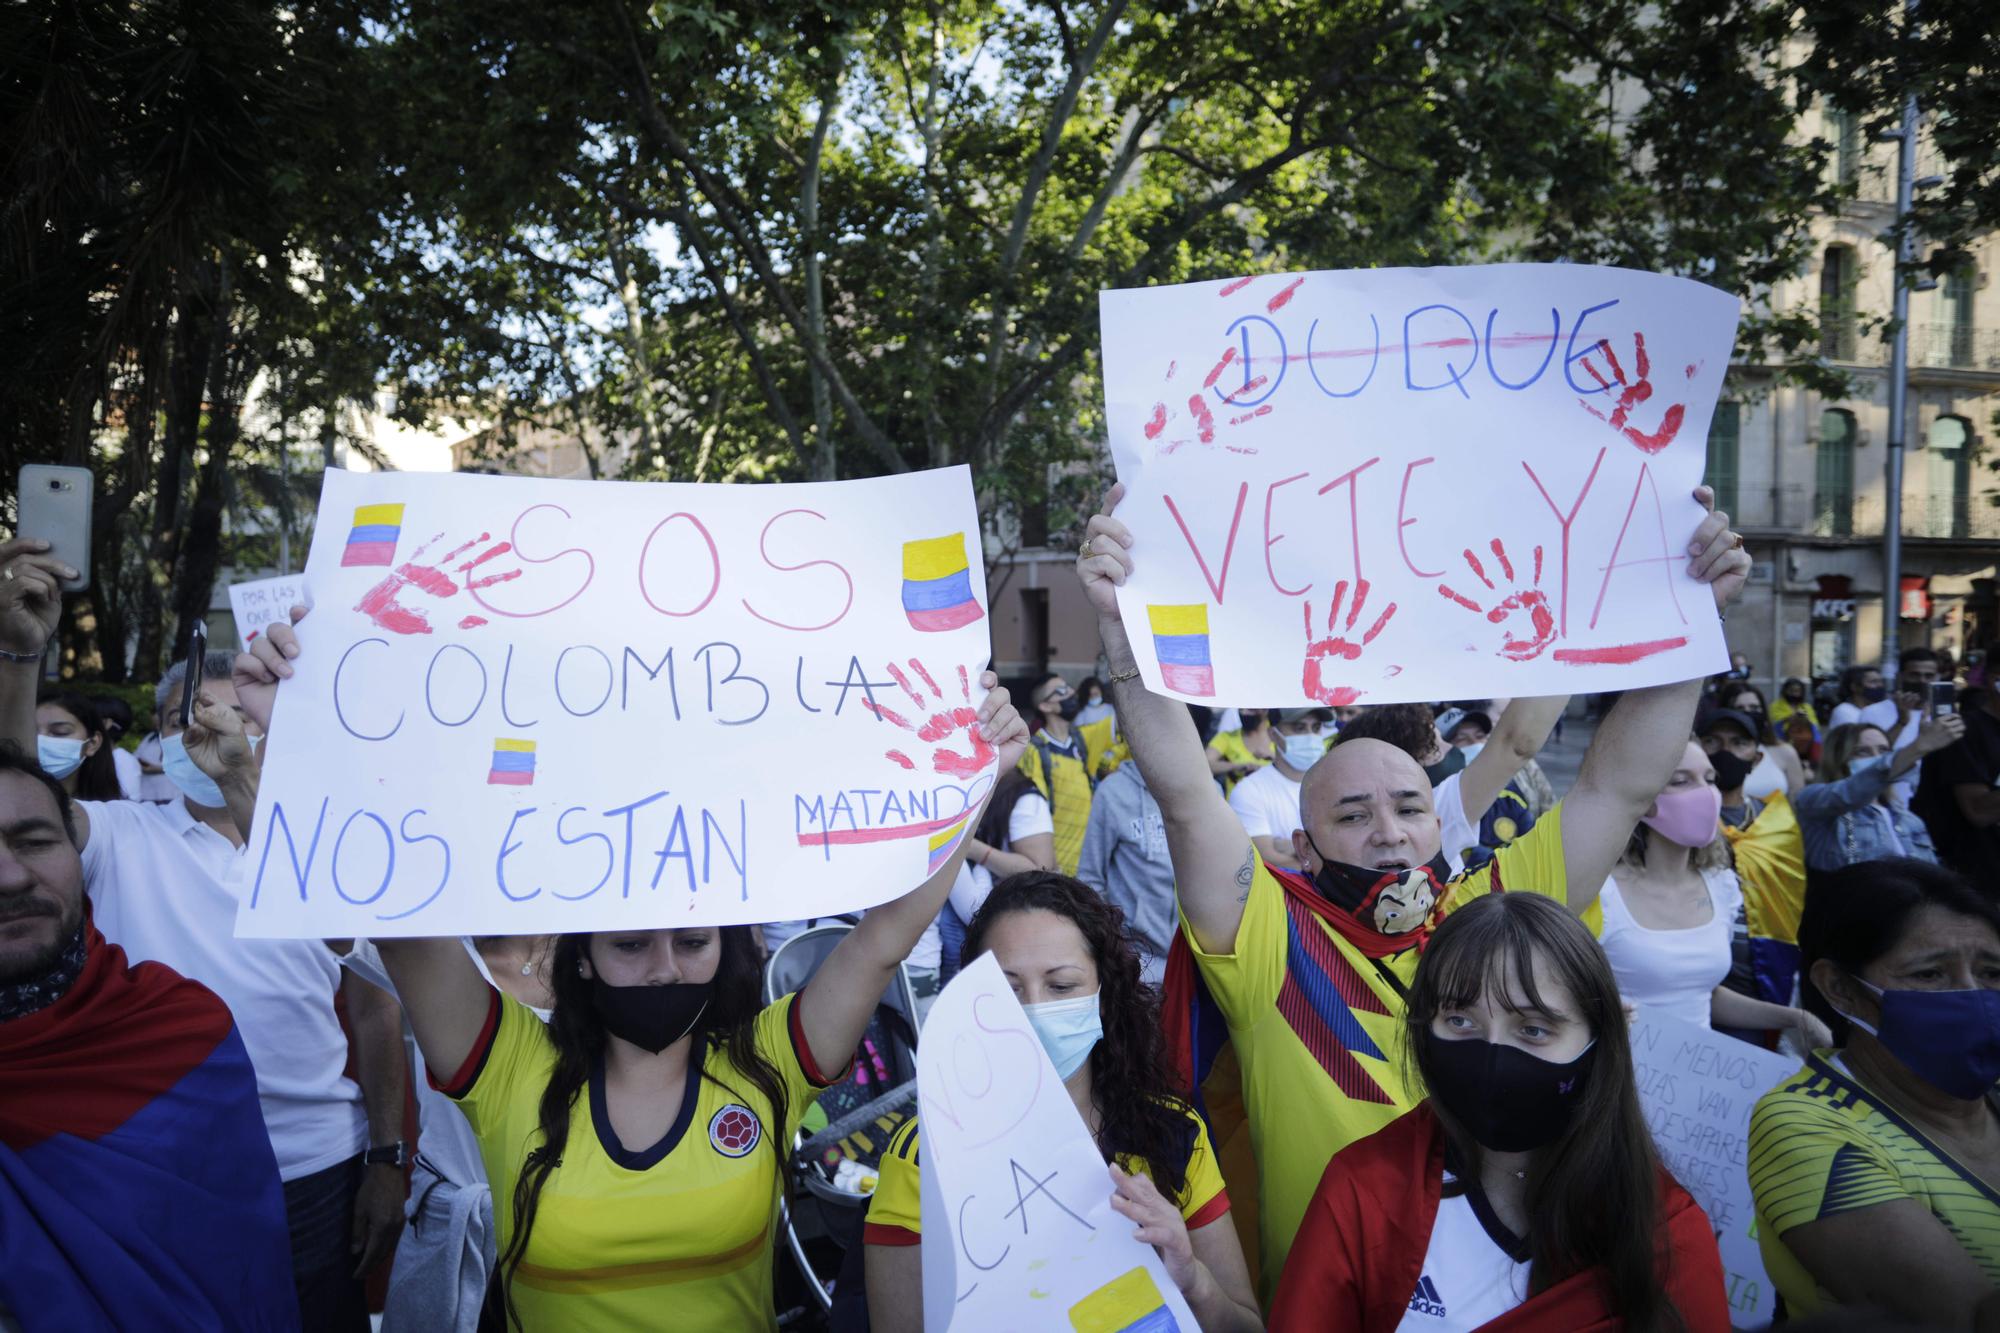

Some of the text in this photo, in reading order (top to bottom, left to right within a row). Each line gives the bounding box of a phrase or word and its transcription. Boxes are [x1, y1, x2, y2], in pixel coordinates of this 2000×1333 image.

[1213, 299, 1620, 407] DUQUE
[465, 503, 853, 631] SOS
[1163, 447, 1688, 638] VETE YA
[241, 586, 295, 606] POR LAS
[1812, 598, 1856, 618] KFC
[333, 637, 897, 742] COLOMBIA
[250, 774, 994, 921] NOS ESTAN MATANDO
[1632, 1023, 1760, 1089] N MENOS
[1635, 1062, 1679, 1105] DIAS
[1697, 1085, 1733, 1120] VAN
[1407, 1293, 1446, 1317] didas
[1726, 1271, 1760, 1312] IA
